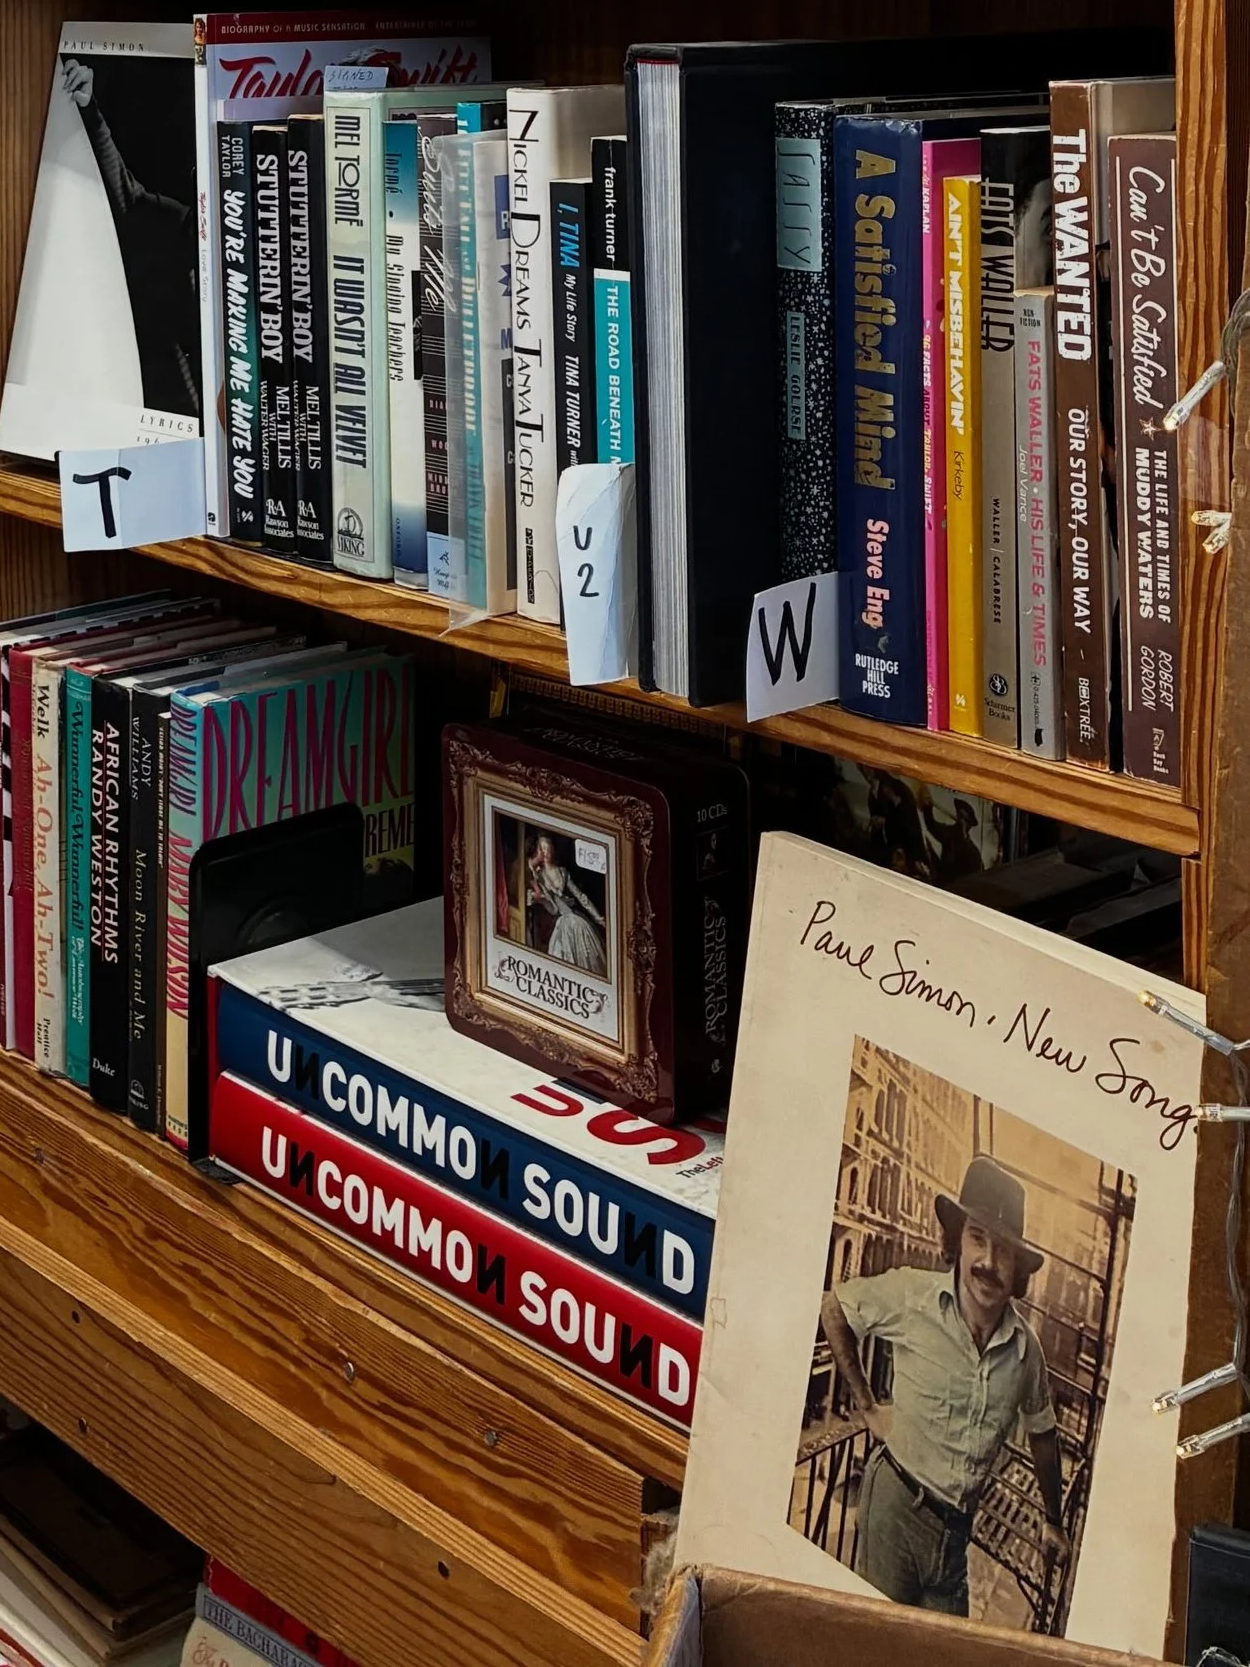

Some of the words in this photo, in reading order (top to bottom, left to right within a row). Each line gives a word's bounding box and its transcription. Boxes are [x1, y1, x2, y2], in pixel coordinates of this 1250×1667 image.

[63, 39, 95, 50] PAUL
[102, 41, 145, 53] SIMON
[327, 70, 374, 85] SIGNED
[223, 135, 231, 179] TAYLOR
[232, 136, 243, 176] COREY
[509, 109, 537, 207] NICKEL
[854, 149, 896, 179] A
[1052, 129, 1086, 194] The
[605, 165, 616, 205] frank
[1128, 166, 1165, 247] Can't
[223, 188, 246, 264] YOU'RE
[256, 154, 282, 309] STUTTERIN'
[288, 149, 312, 308] STUTTERIN'
[606, 207, 615, 262] turner
[510, 214, 541, 330] DREAMS
[854, 194, 896, 374] Satisfied
[1053, 198, 1091, 363] WANTED
[1128, 248, 1165, 287] Be
[224, 269, 249, 356] MAKING
[607, 285, 619, 319] THE
[260, 310, 283, 363] BOY
[291, 310, 313, 363] BOY
[608, 321, 620, 369] ROAD
[1130, 289, 1165, 406] Satisfied
[229, 360, 251, 391] ME
[514, 338, 542, 411] TANYA
[139, 414, 194, 433] LYRICS
[231, 396, 254, 453] HATE
[608, 374, 622, 451] BENEATH
[854, 384, 896, 489] Mind
[1068, 408, 1089, 444] OUR
[233, 455, 255, 499] YOU
[516, 417, 544, 507] TUCKER
[1134, 448, 1152, 528] MUDDY
[1154, 449, 1167, 476] THE
[73, 466, 132, 538] T
[1068, 448, 1088, 534] STORY,
[1154, 481, 1168, 511] LIFE
[866, 519, 890, 579] Steve
[1155, 515, 1169, 543] AND
[1071, 538, 1089, 579] OUR
[1137, 531, 1153, 620] WATERS
[1155, 548, 1170, 595] TIMES
[757, 581, 817, 686] W
[861, 585, 891, 630] Eng
[1071, 584, 1091, 634] WAY
[1156, 601, 1171, 624] OF
[855, 653, 899, 676] RUTLEDGE
[862, 678, 891, 698] PRESS
[866, 668, 886, 684] HILL
[1140, 645, 1156, 711] GORDON
[1156, 650, 1172, 712] ROBERT
[37, 684, 49, 739] Welk
[92, 730, 103, 823] RANDY
[105, 722, 119, 833] AFRICAN
[131, 716, 140, 800] WILLIAMS
[140, 737, 152, 785] ANDY
[203, 661, 415, 840] DREAMGIRL
[37, 752, 53, 865] Ah-One,
[91, 831, 102, 945] WESTON
[104, 839, 119, 964] RHYTHMS
[36, 877, 53, 999] Ah-Two!
[507, 955, 595, 1003] ROMANTIC
[516, 978, 590, 1019] CLASSICS
[800, 901, 875, 979] Paul
[878, 939, 976, 1027] Simon
[1004, 1004, 1087, 1072] New
[92, 1059, 116, 1076] Duke
